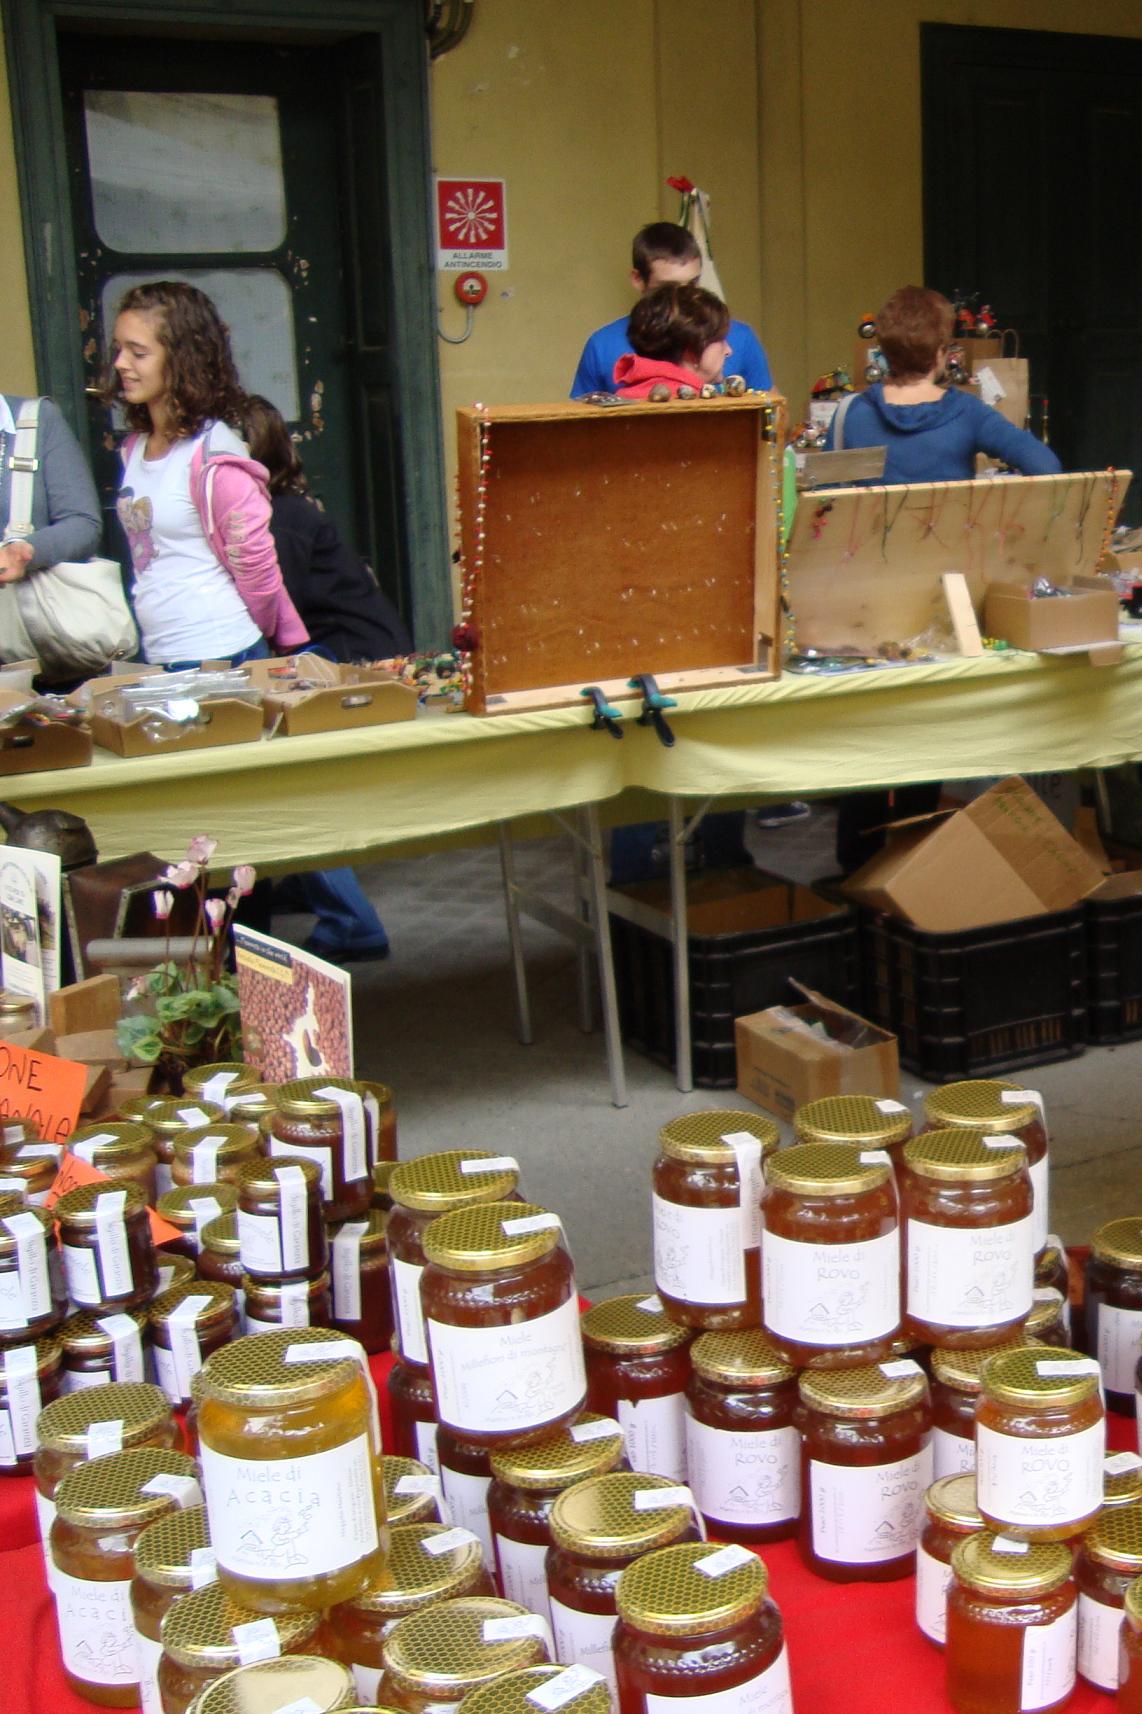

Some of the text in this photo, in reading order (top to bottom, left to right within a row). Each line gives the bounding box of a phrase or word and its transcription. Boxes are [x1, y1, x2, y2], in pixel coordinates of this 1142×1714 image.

[453, 252, 493, 260] ALLARME
[444, 261, 503, 269] ANTINCENDIO
[813, 1248, 850, 1264] Miele
[973, 1249, 1010, 1266] ROVO
[817, 1267, 861, 1282] ROVO
[499, 1331, 533, 1346] Miele
[729, 1436, 768, 1450] Miele
[735, 1453, 778, 1467] ROVO
[1022, 1458, 1071, 1475] ROVO
[235, 1464, 302, 1484] Miele di
[226, 1488, 321, 1507] Acacia
[881, 1480, 918, 1502] ROVO
[72, 1585, 106, 1602] Miele
[63, 1602, 129, 1622] Acaci
